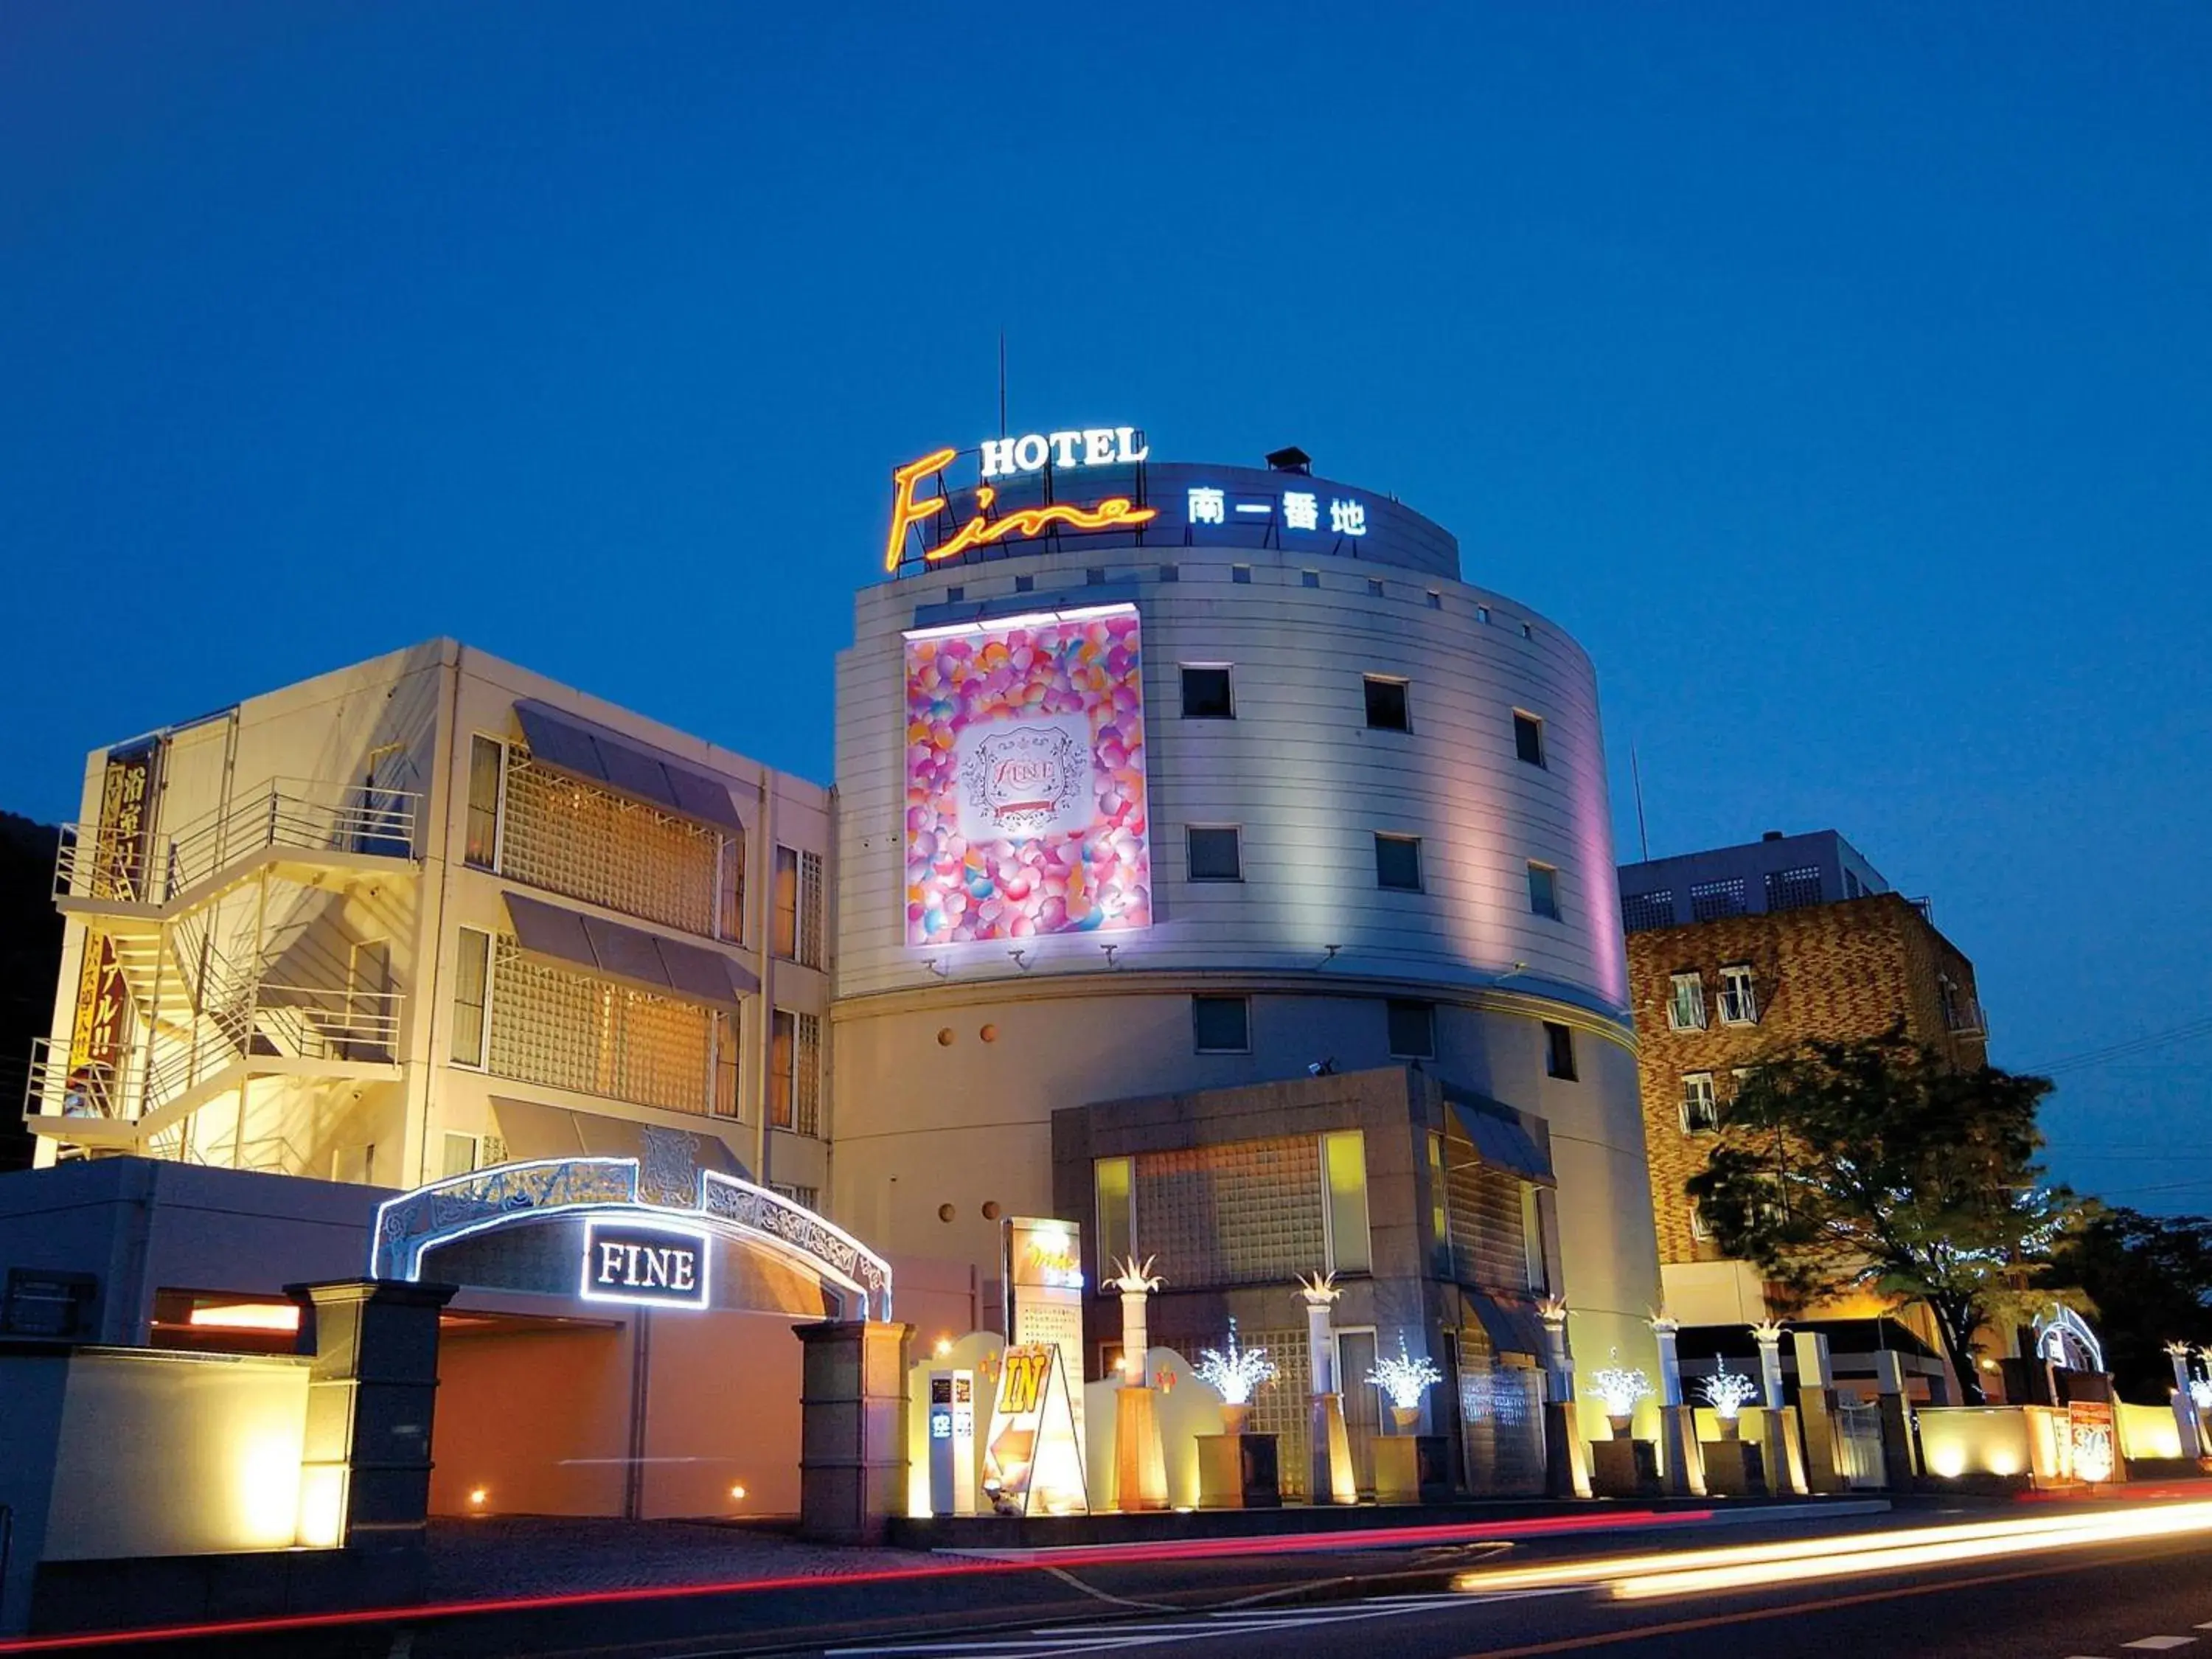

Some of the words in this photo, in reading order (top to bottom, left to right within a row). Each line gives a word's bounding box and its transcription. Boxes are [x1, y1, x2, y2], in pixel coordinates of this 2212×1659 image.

[981, 427, 1149, 477] HOTEL
[886, 448, 1156, 572] Fine
[1187, 486, 1367, 536] 南一番地
[598, 1242, 695, 1290] FINE
[998, 1355, 1046, 1413] IN
